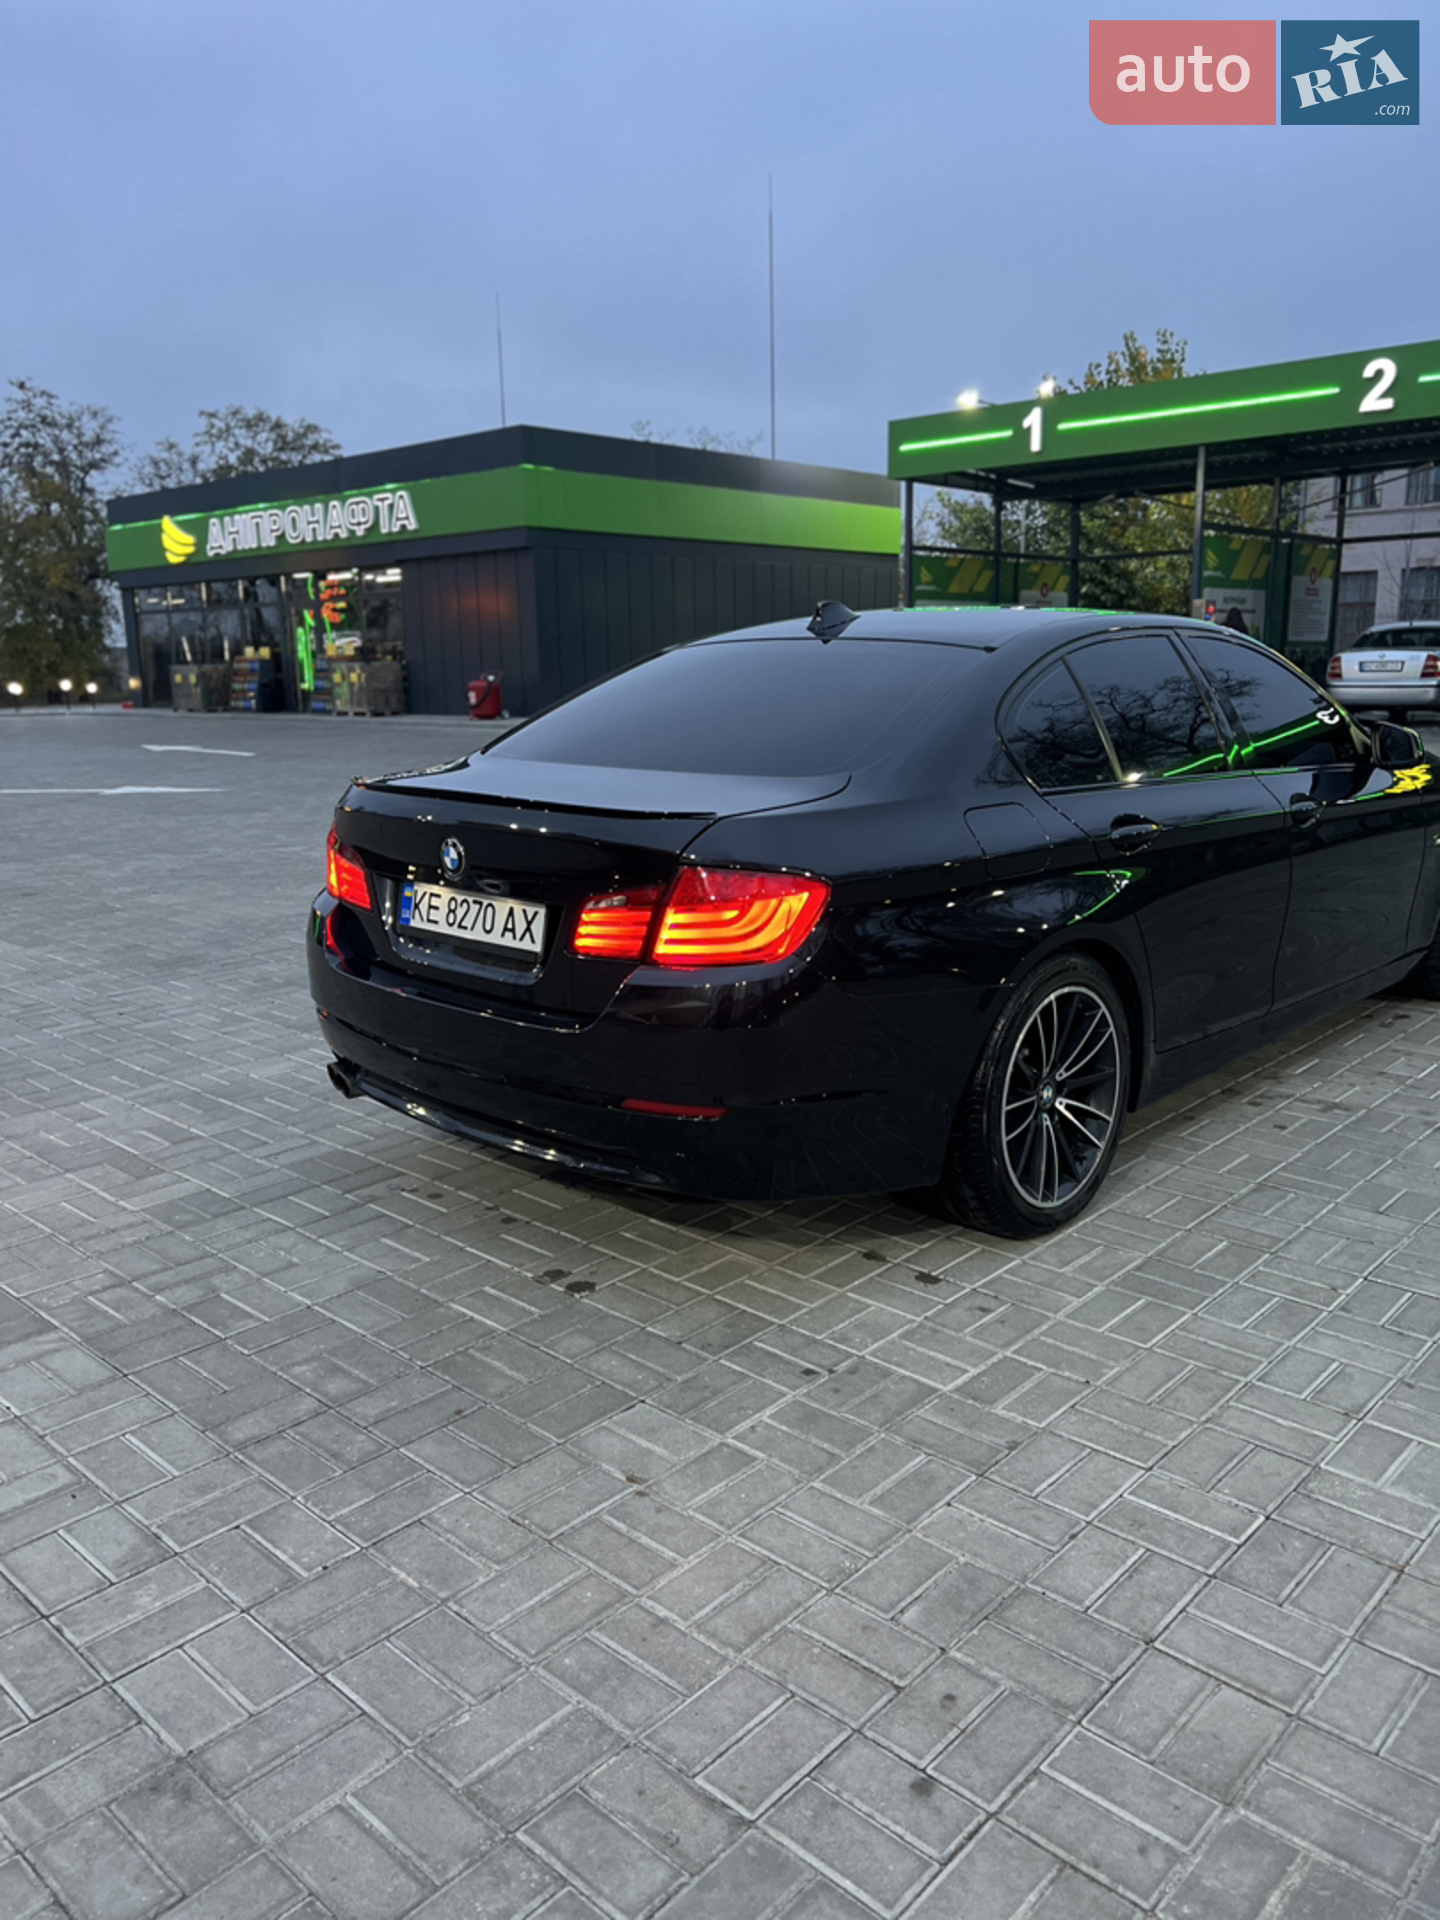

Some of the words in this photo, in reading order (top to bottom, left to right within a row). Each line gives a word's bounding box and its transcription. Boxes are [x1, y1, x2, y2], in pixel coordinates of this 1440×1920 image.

[1358, 357, 1397, 413] 2
[1022, 406, 1042, 453] 1
[206, 490, 419, 557] ДНІПРОНАФТА
[412, 888, 442, 925] KE
[445, 896, 497, 935] 8270
[500, 905, 540, 945] AX
